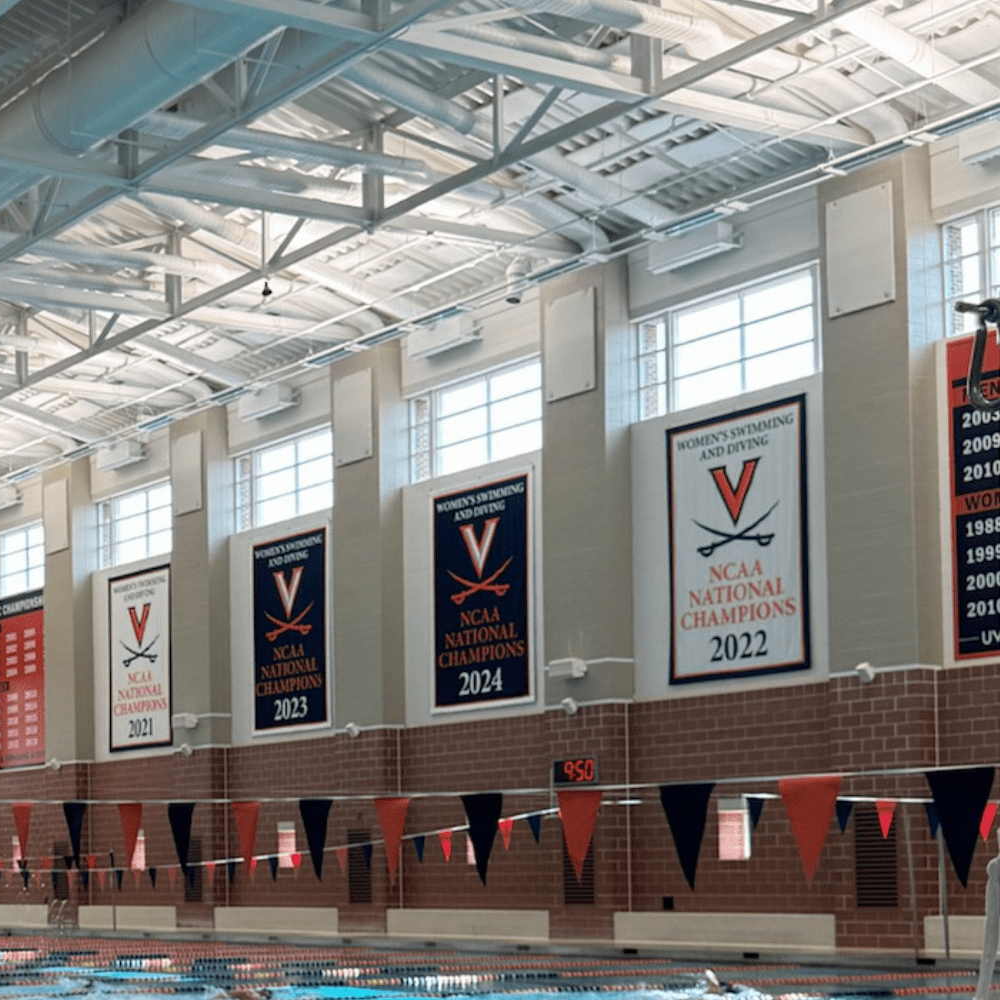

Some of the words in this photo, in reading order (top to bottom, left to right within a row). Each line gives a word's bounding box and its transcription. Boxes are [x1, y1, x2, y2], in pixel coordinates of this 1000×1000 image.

[962, 380, 1000, 402] EN
[677, 429, 729, 452] WOMEN'S
[730, 411, 795, 439] SWIMMING
[962, 432, 1000, 455] 2009
[699, 444, 725, 462] AND
[727, 433, 769, 456] DIVING
[963, 459, 1000, 482] 2010
[436, 494, 476, 513] WOMEN'S
[476, 481, 525, 504] SWIMMING
[453, 508, 474, 523] AND
[474, 499, 507, 518] DIVING
[965, 516, 1000, 538] 1988
[966, 543, 1000, 565] 1999
[709, 558, 763, 584] NCAA
[688, 576, 784, 609] NATIONAL
[460, 605, 501, 628] NCAA
[680, 596, 797, 631] CHAMPIONS
[444, 621, 519, 650] NATIONAL
[709, 629, 768, 662] 2022
[273, 643, 305, 661] NCAA
[438, 639, 525, 669] CHAMPIONS
[260, 656, 319, 680] NATIONAL
[117, 684, 164, 701] NATIONAL
[255, 673, 323, 697] CHAMPIONS
[458, 666, 503, 697] 2024
[113, 697, 168, 716] CHAMPIONS
[273, 695, 309, 721] 2023
[128, 717, 153, 738] 2021
